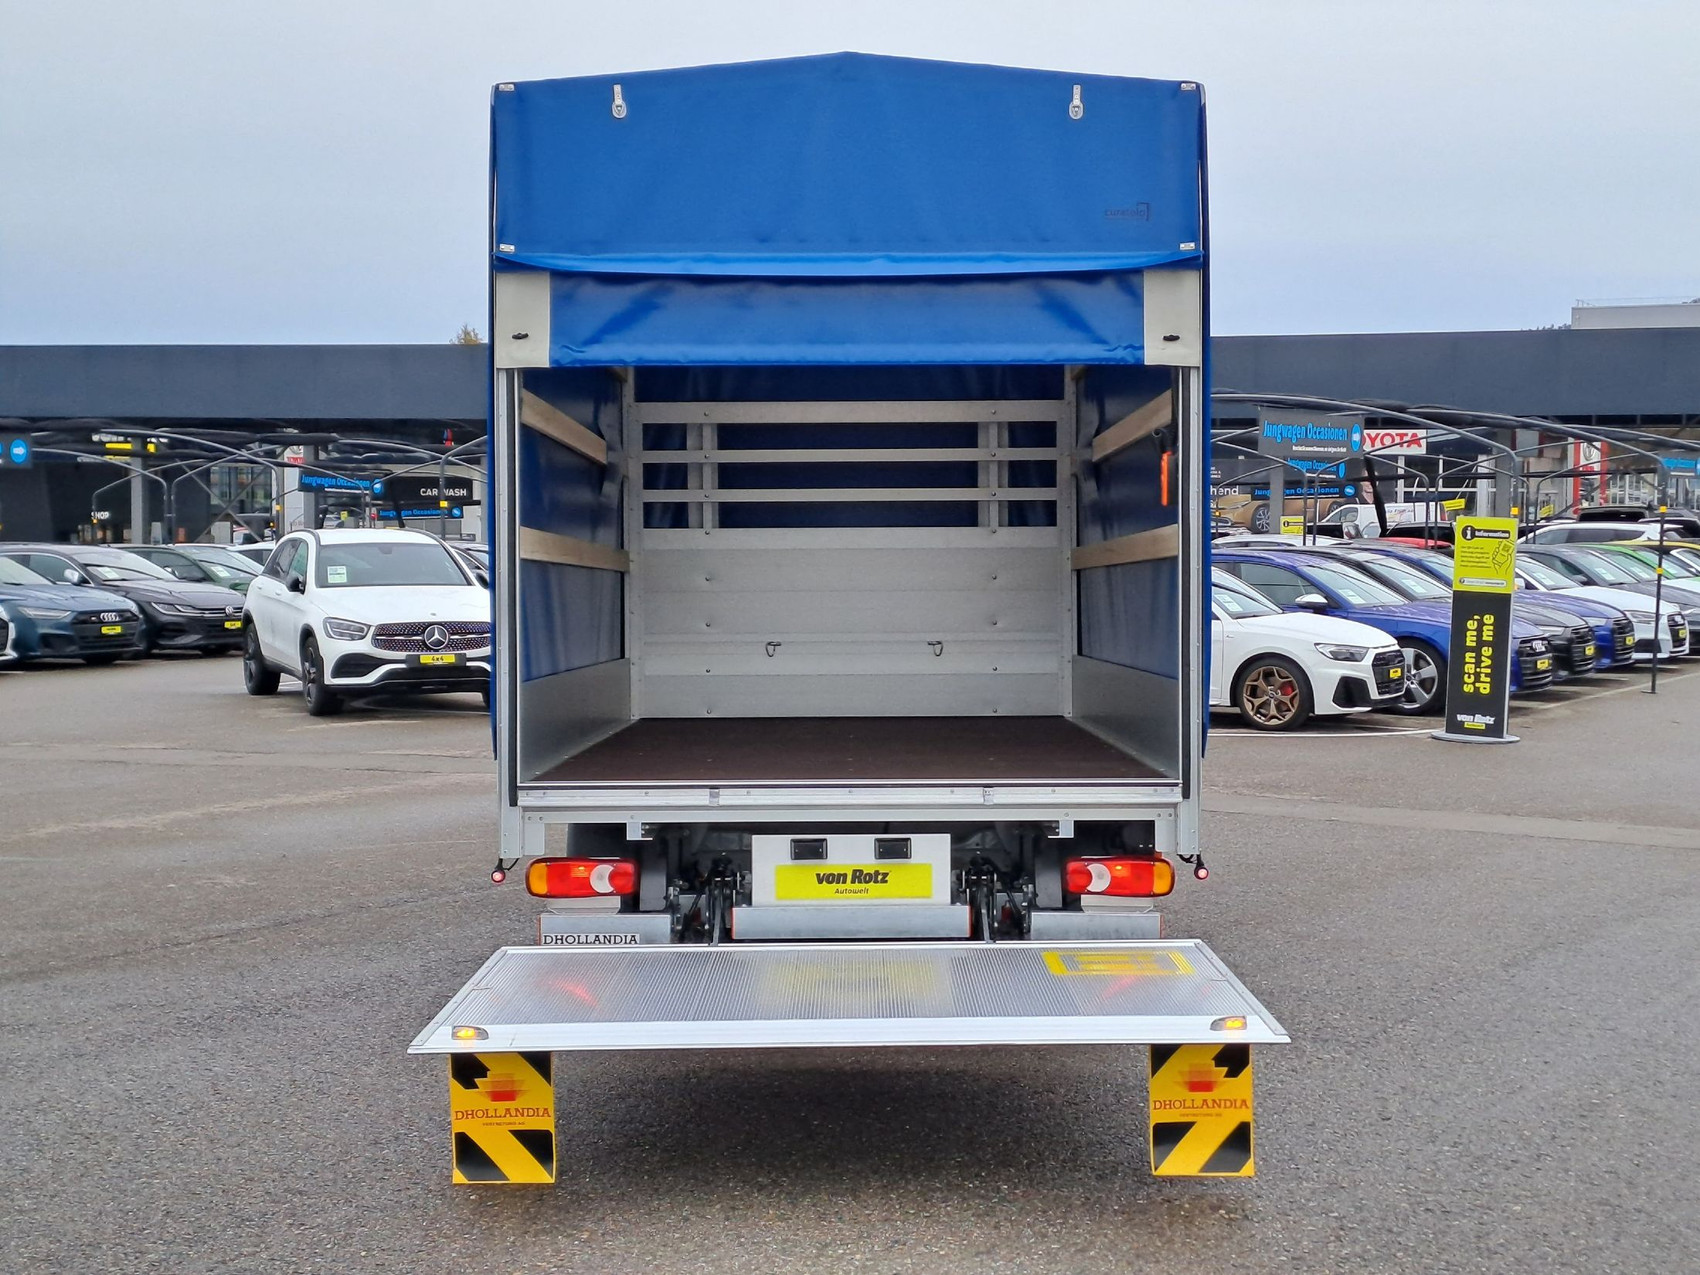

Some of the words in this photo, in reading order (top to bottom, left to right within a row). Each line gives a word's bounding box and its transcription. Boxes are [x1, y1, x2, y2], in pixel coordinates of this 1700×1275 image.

[1263, 420, 1307, 443] Jungwagen
[1307, 422, 1348, 441] Occasionen
[1364, 432, 1422, 448] YOTA
[420, 488, 438, 496] CAR
[1466, 615, 1480, 646] me,
[1482, 614, 1495, 641] me
[1464, 652, 1476, 693] scan
[1475, 646, 1493, 694] drive
[815, 872, 847, 884] von
[851, 869, 890, 884] Rotz
[543, 934, 638, 945] DHOLLANDIA
[1153, 1099, 1250, 1110] DHOLLANDIA
[455, 1107, 551, 1120] DHOLLANDIA
